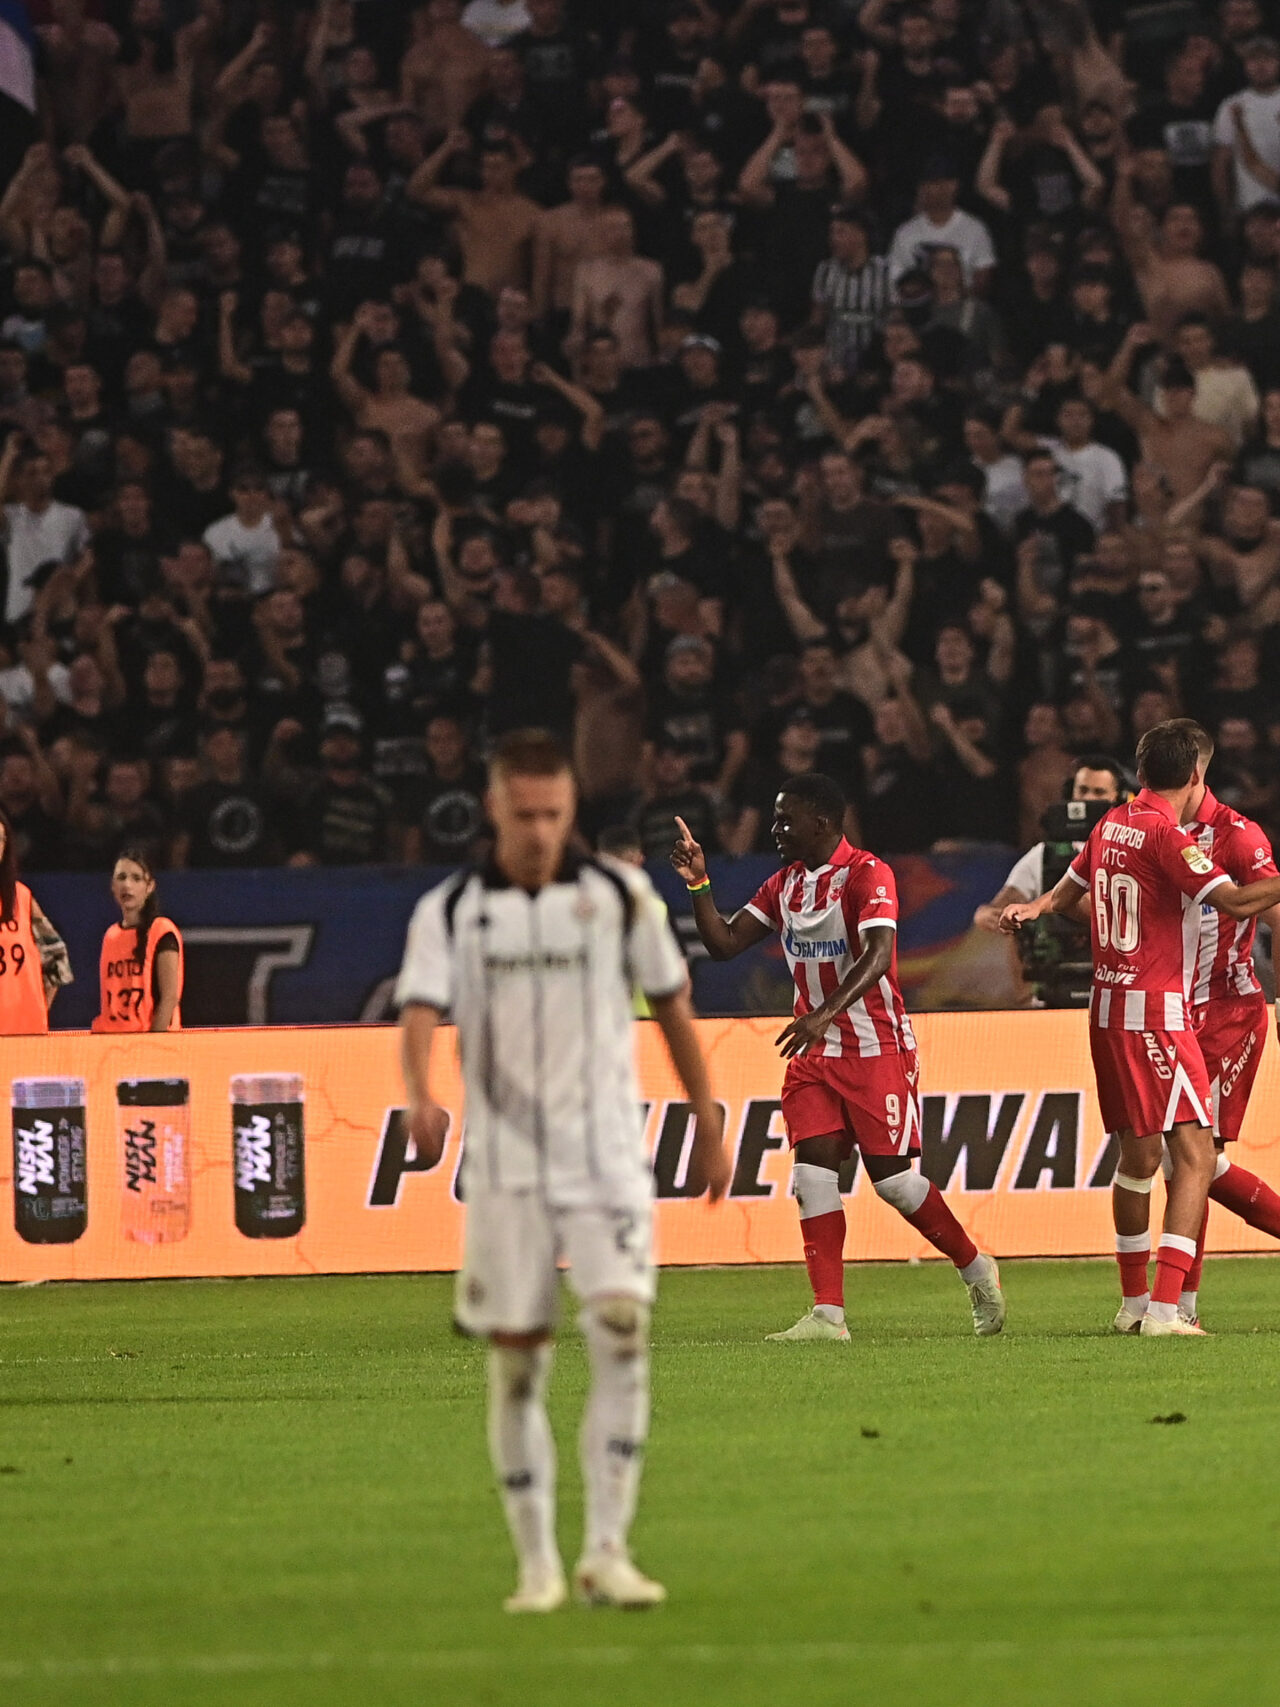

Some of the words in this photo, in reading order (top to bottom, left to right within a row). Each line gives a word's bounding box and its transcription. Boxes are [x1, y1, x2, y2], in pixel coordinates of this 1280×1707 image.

[1101, 846, 1128, 868] ИТС
[1094, 867, 1142, 956] 60
[801, 938, 847, 958] GAZPROM
[885, 1093, 900, 1126] 9
[919, 1091, 1121, 1191] WA
[18, 1127, 38, 1195] NISH
[33, 1119, 54, 1184] MAN
[124, 1128, 142, 1192] NISH
[138, 1119, 156, 1184] MAN
[250, 1115, 271, 1182] MAN
